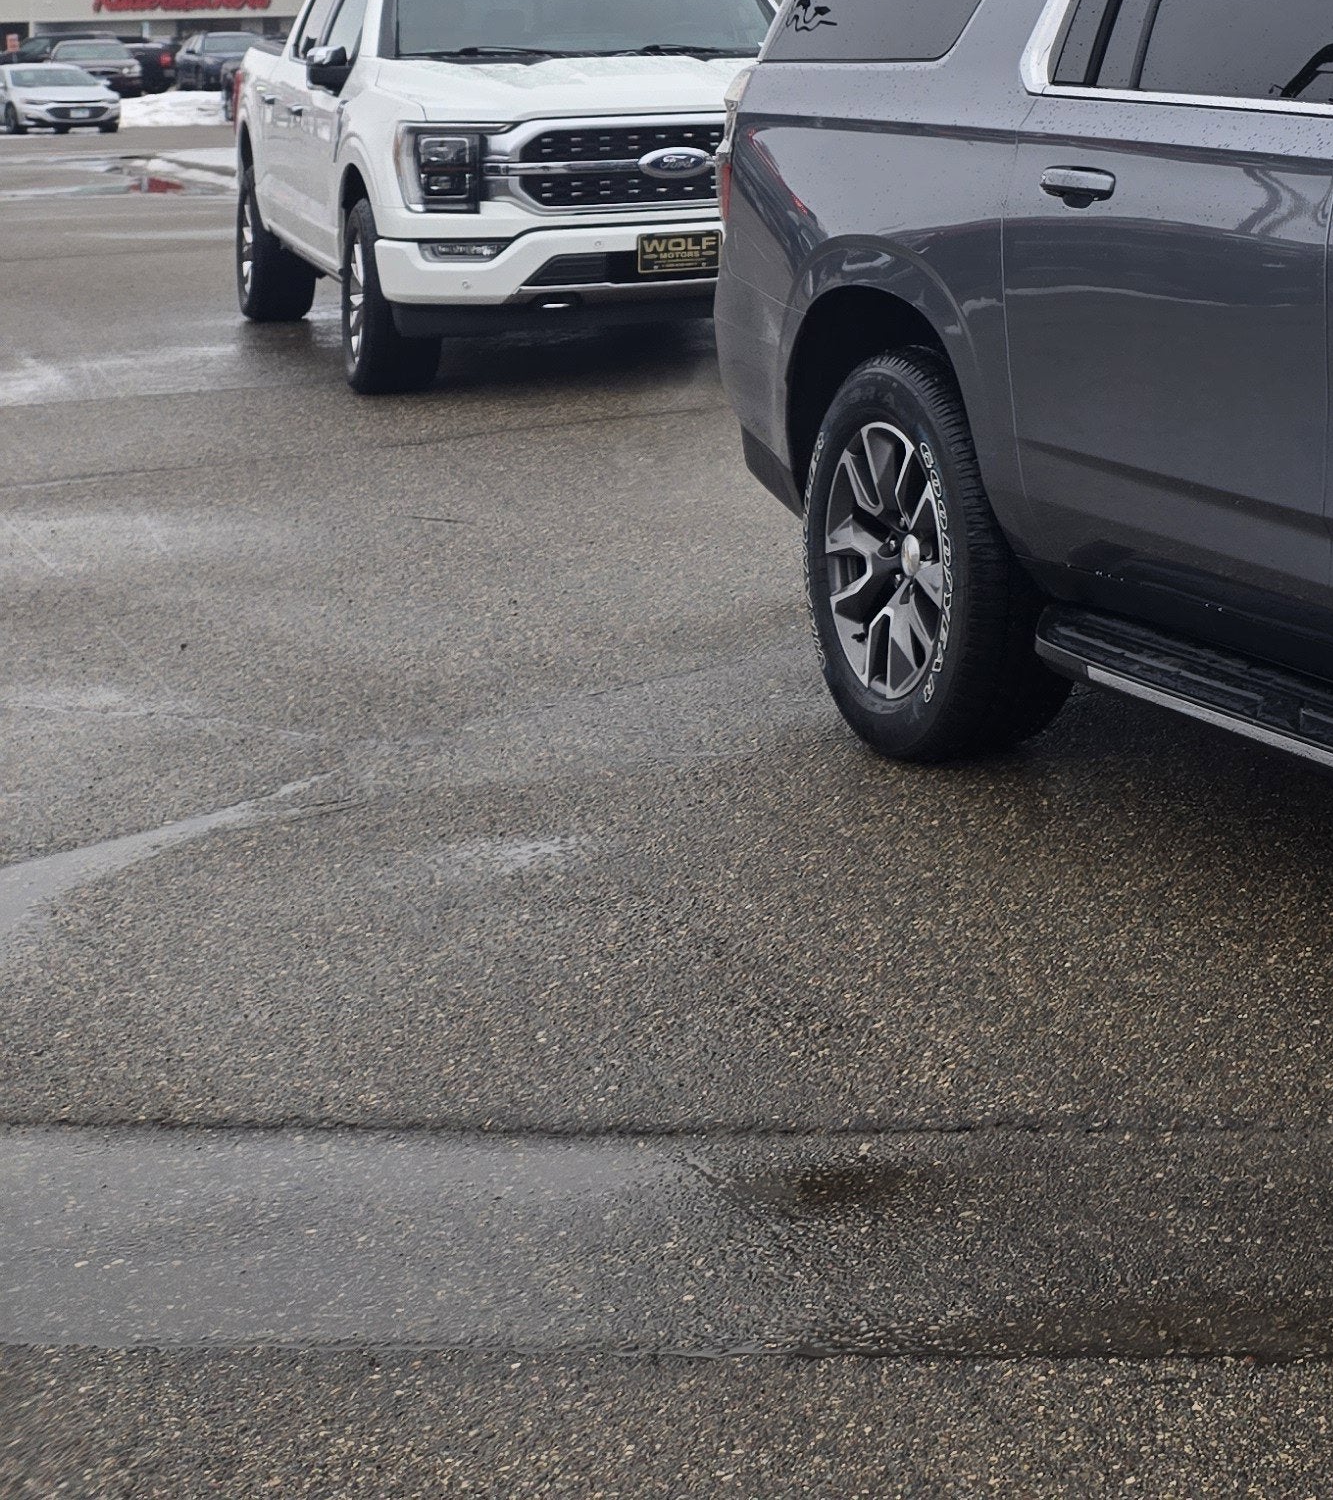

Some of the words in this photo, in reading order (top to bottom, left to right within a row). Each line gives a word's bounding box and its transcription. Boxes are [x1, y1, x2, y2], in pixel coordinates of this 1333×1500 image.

[660, 155, 696, 169] Ford
[642, 236, 717, 253] WOLF
[659, 250, 700, 260] MOTORS
[919, 441, 954, 703] GOODYEAR
